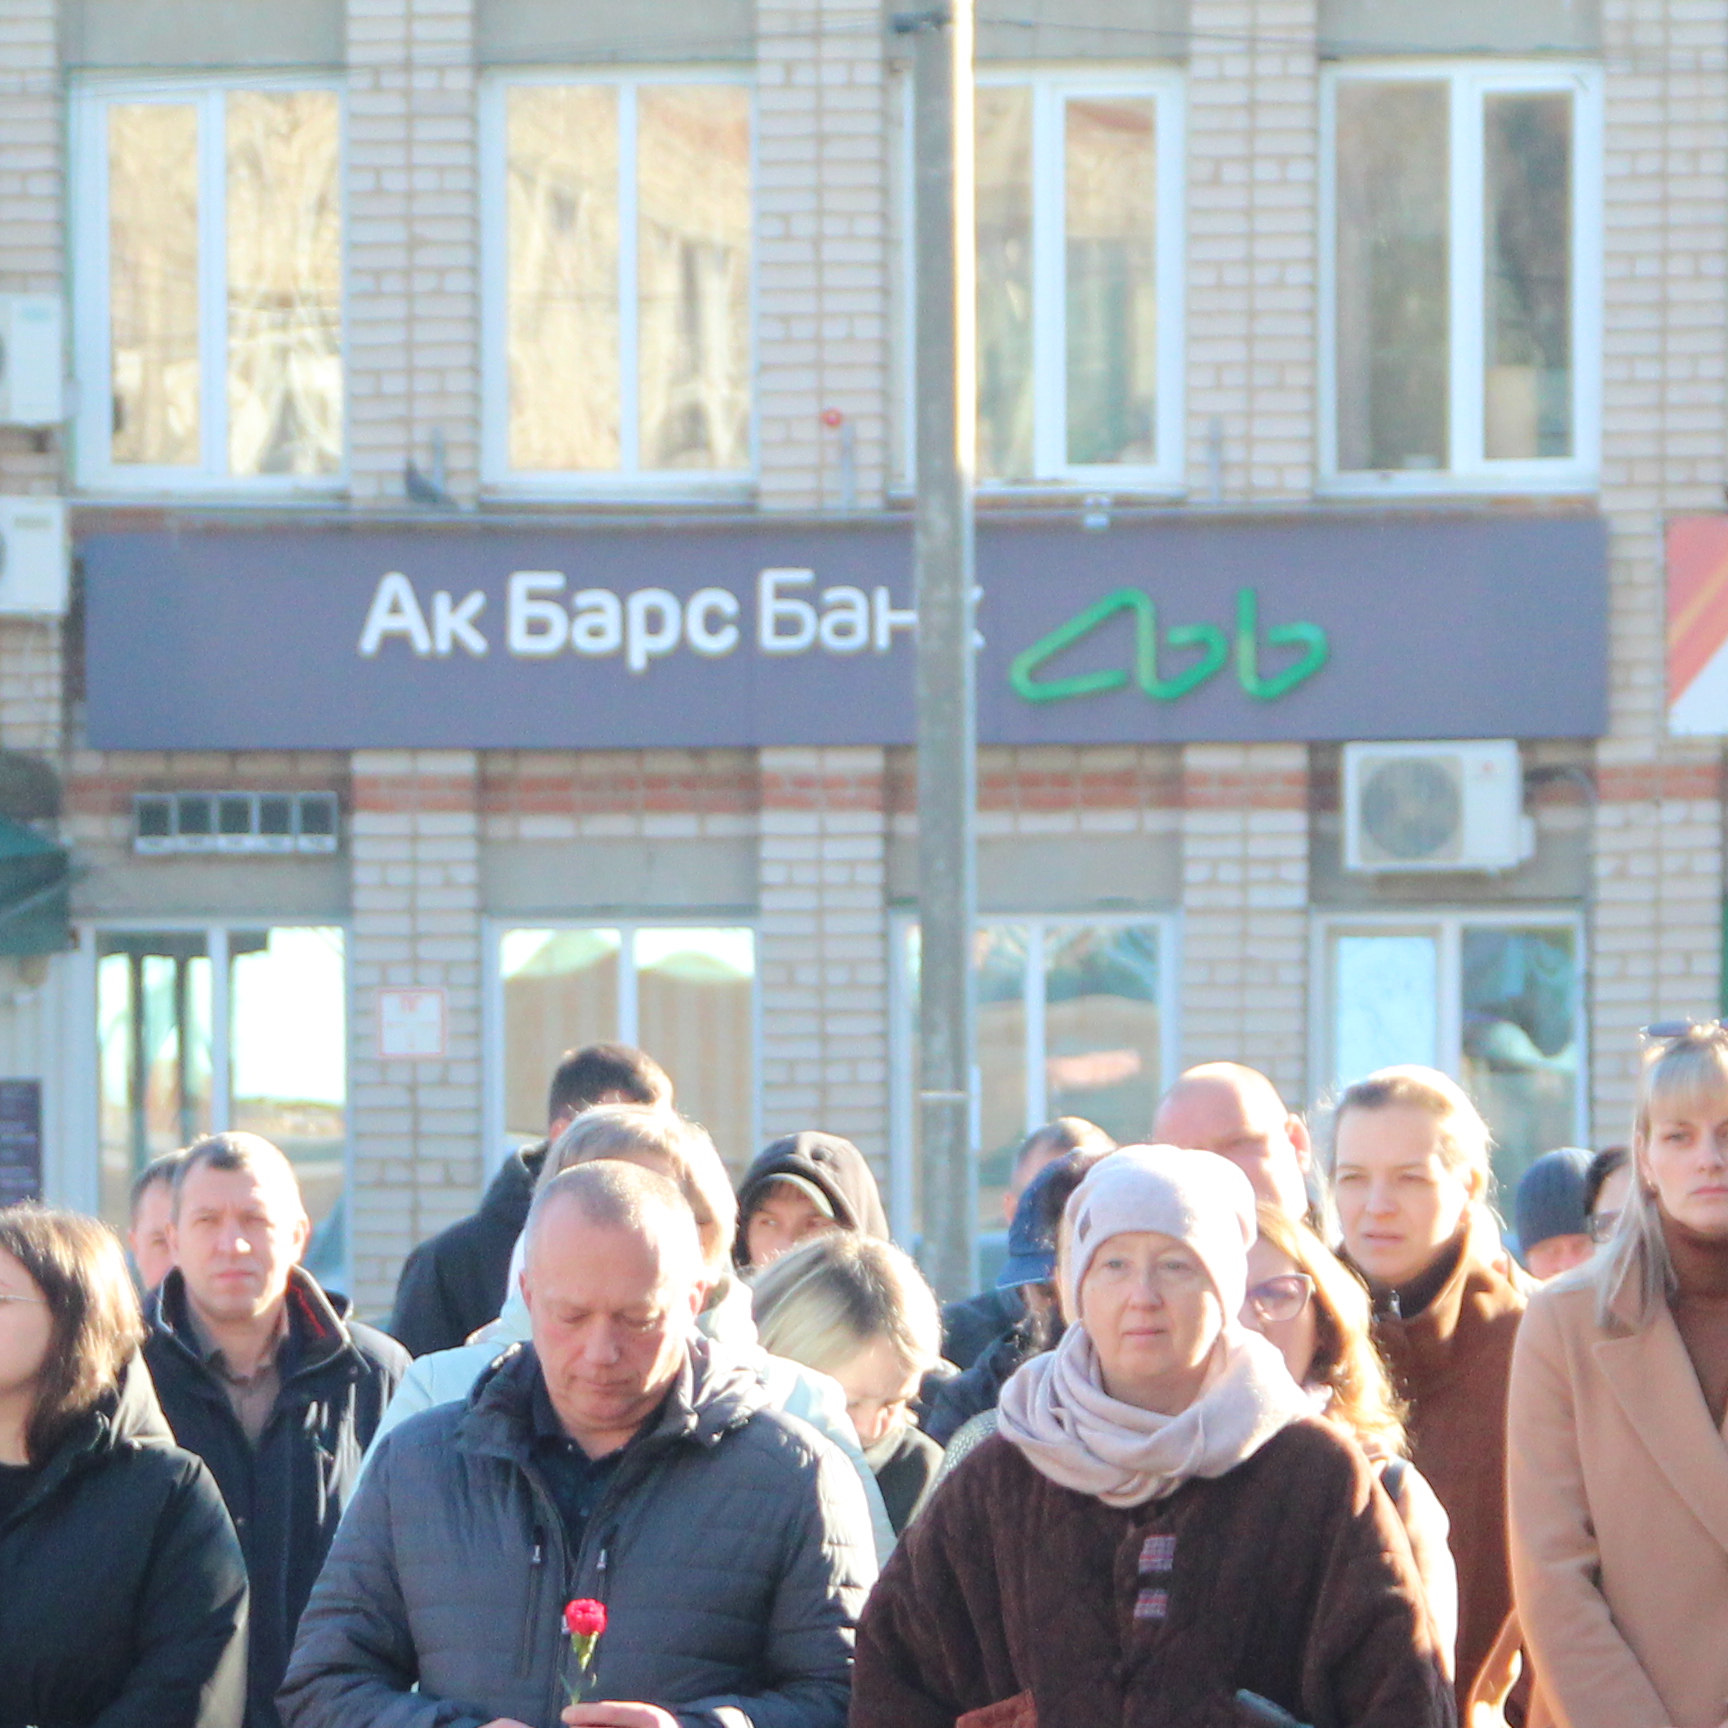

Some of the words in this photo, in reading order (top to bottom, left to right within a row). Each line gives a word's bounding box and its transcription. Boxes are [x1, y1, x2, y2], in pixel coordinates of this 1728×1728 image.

[359, 570, 489, 658] Ак
[506, 569, 741, 674] Барс
[758, 566, 986, 655] Бан
